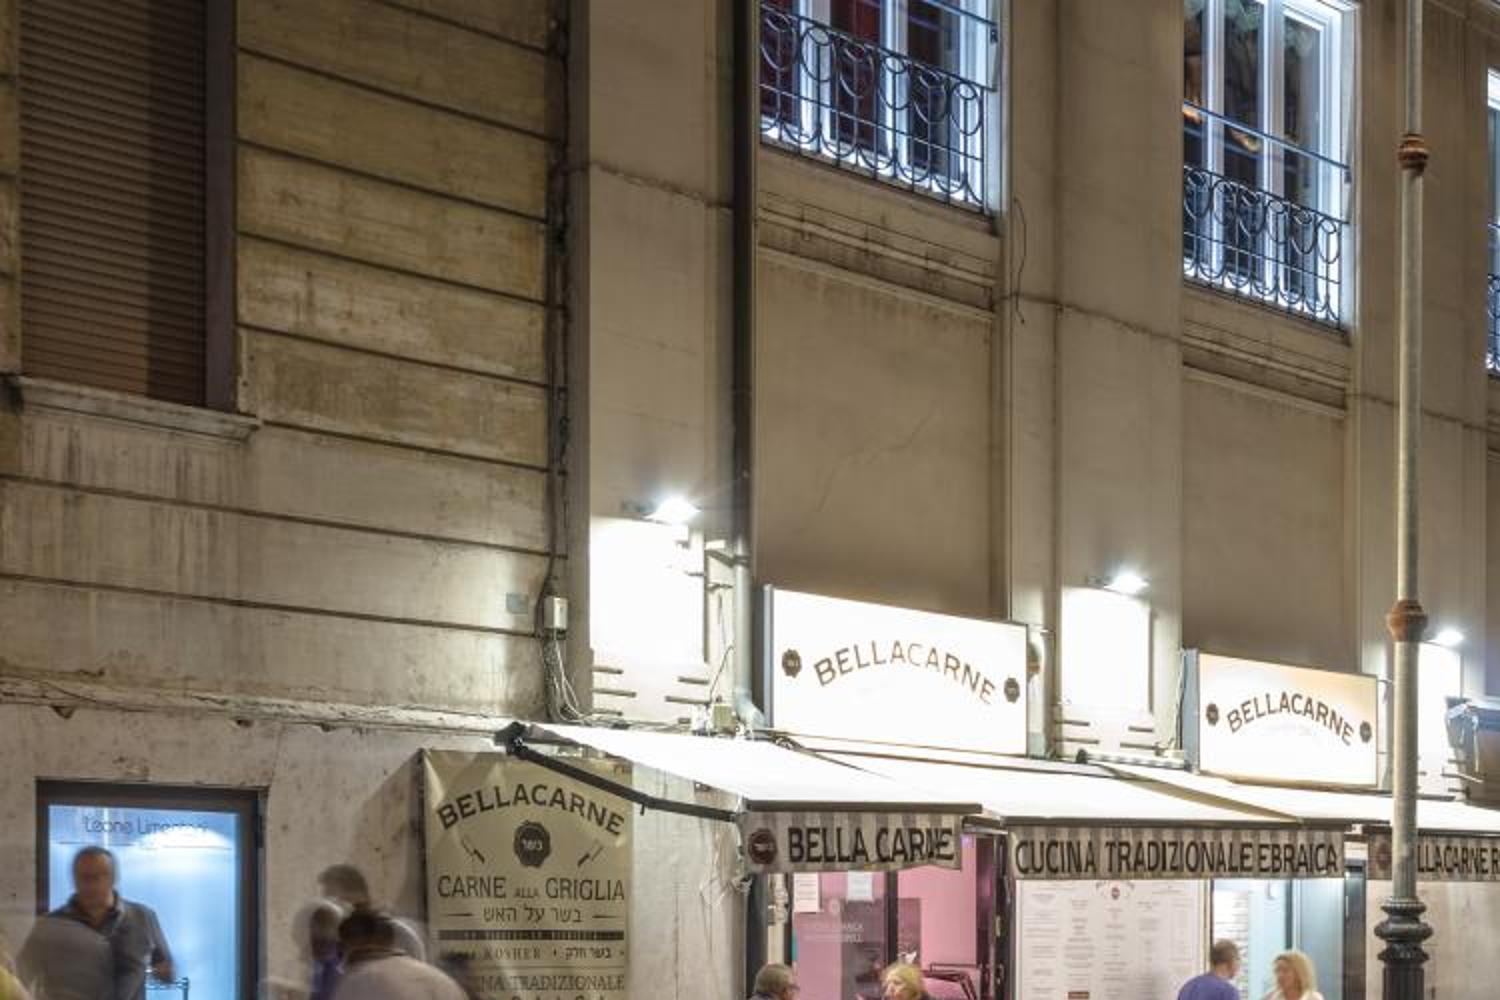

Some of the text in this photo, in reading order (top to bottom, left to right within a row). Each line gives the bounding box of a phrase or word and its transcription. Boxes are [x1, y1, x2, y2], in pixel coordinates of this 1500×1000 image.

[813, 640, 995, 704] BELLACARNE
[1227, 691, 1355, 746] BELLACARNE
[437, 783, 625, 836] BELLACARNE
[787, 827, 955, 863] BELLA CARNE
[1014, 840, 1339, 875] CUCINA TRADIZIONALE EBRAICA
[1416, 844, 1489, 873] LLACARNE
[437, 875, 507, 898] CARNE
[545, 877, 625, 900] GRIGLIA
